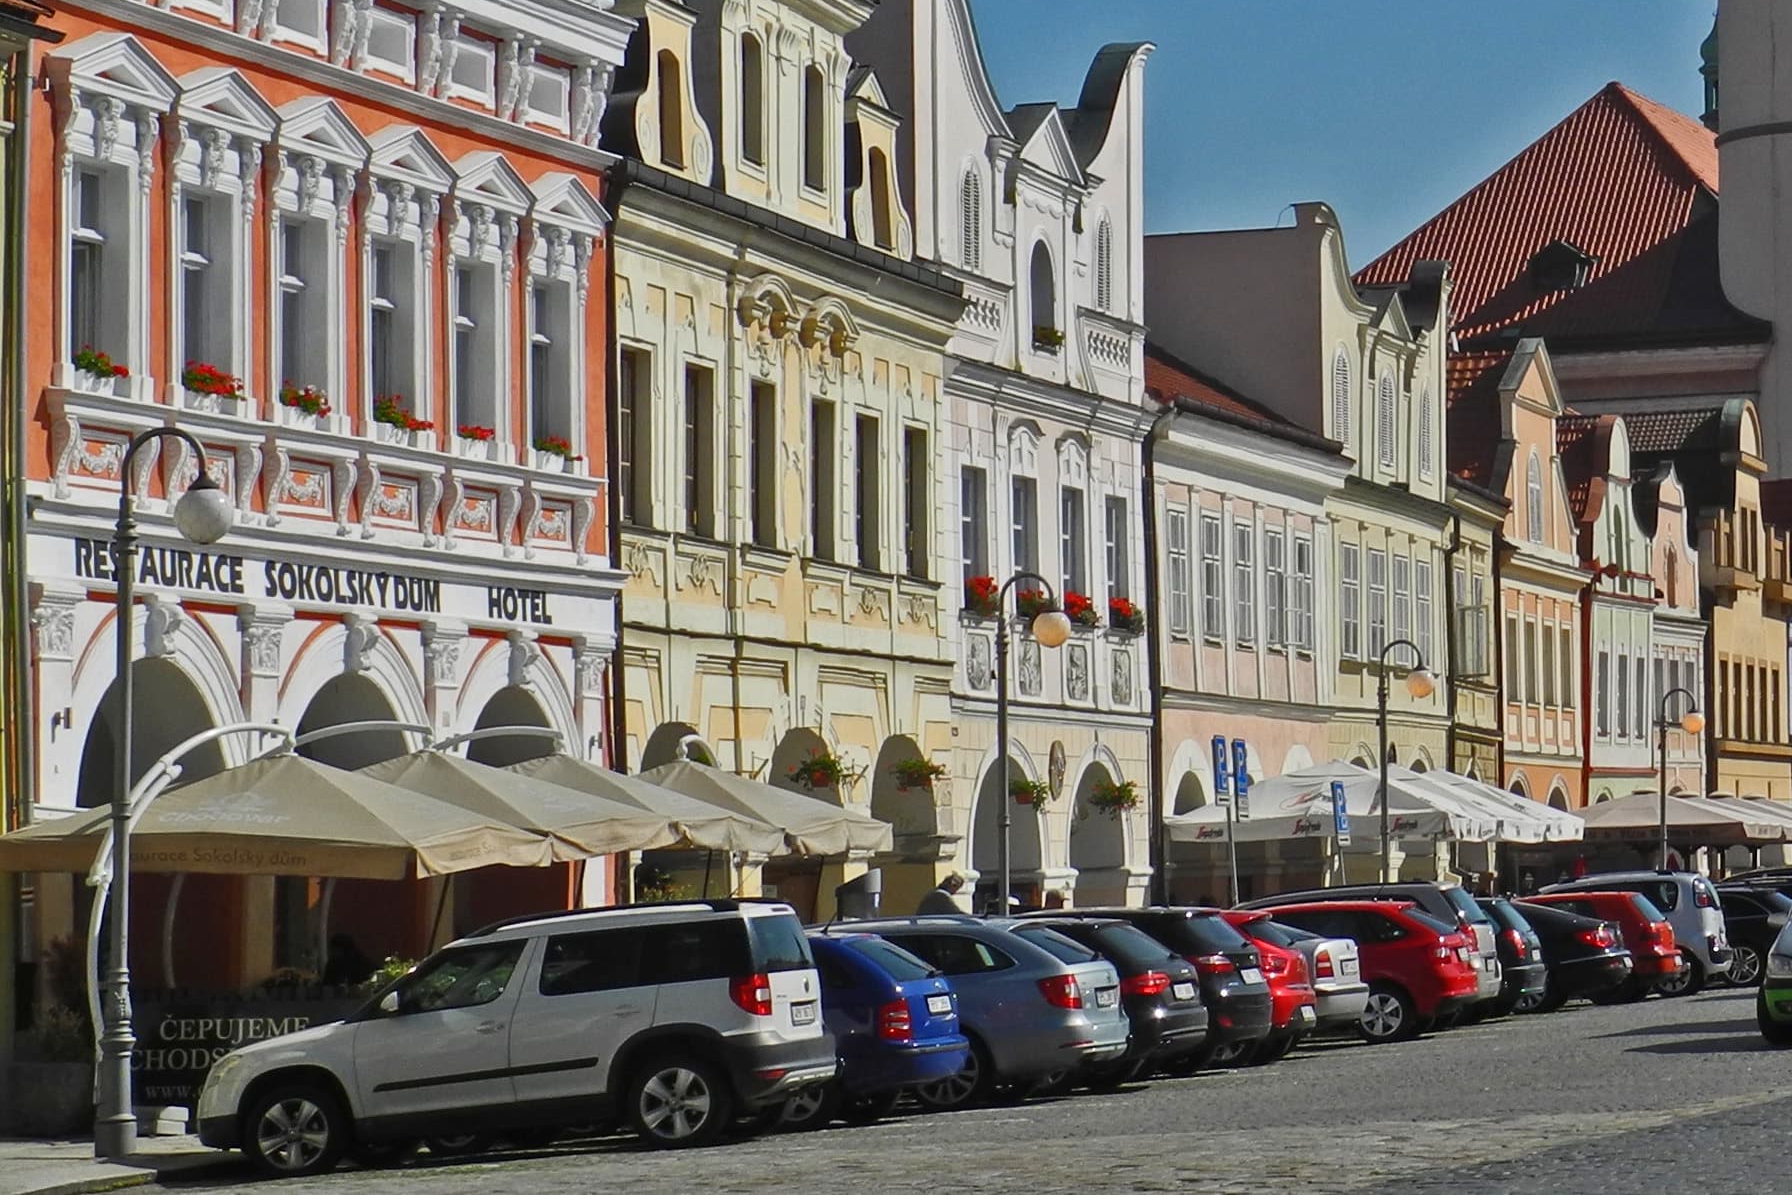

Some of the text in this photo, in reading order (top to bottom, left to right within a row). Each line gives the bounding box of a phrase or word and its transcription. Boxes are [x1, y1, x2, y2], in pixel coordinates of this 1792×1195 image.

[75, 537, 244, 593] RESAURACE
[487, 586, 553, 624] HOTEL
[159, 1014, 310, 1044] ČEPUJEME
[130, 1047, 236, 1071] CHODS
